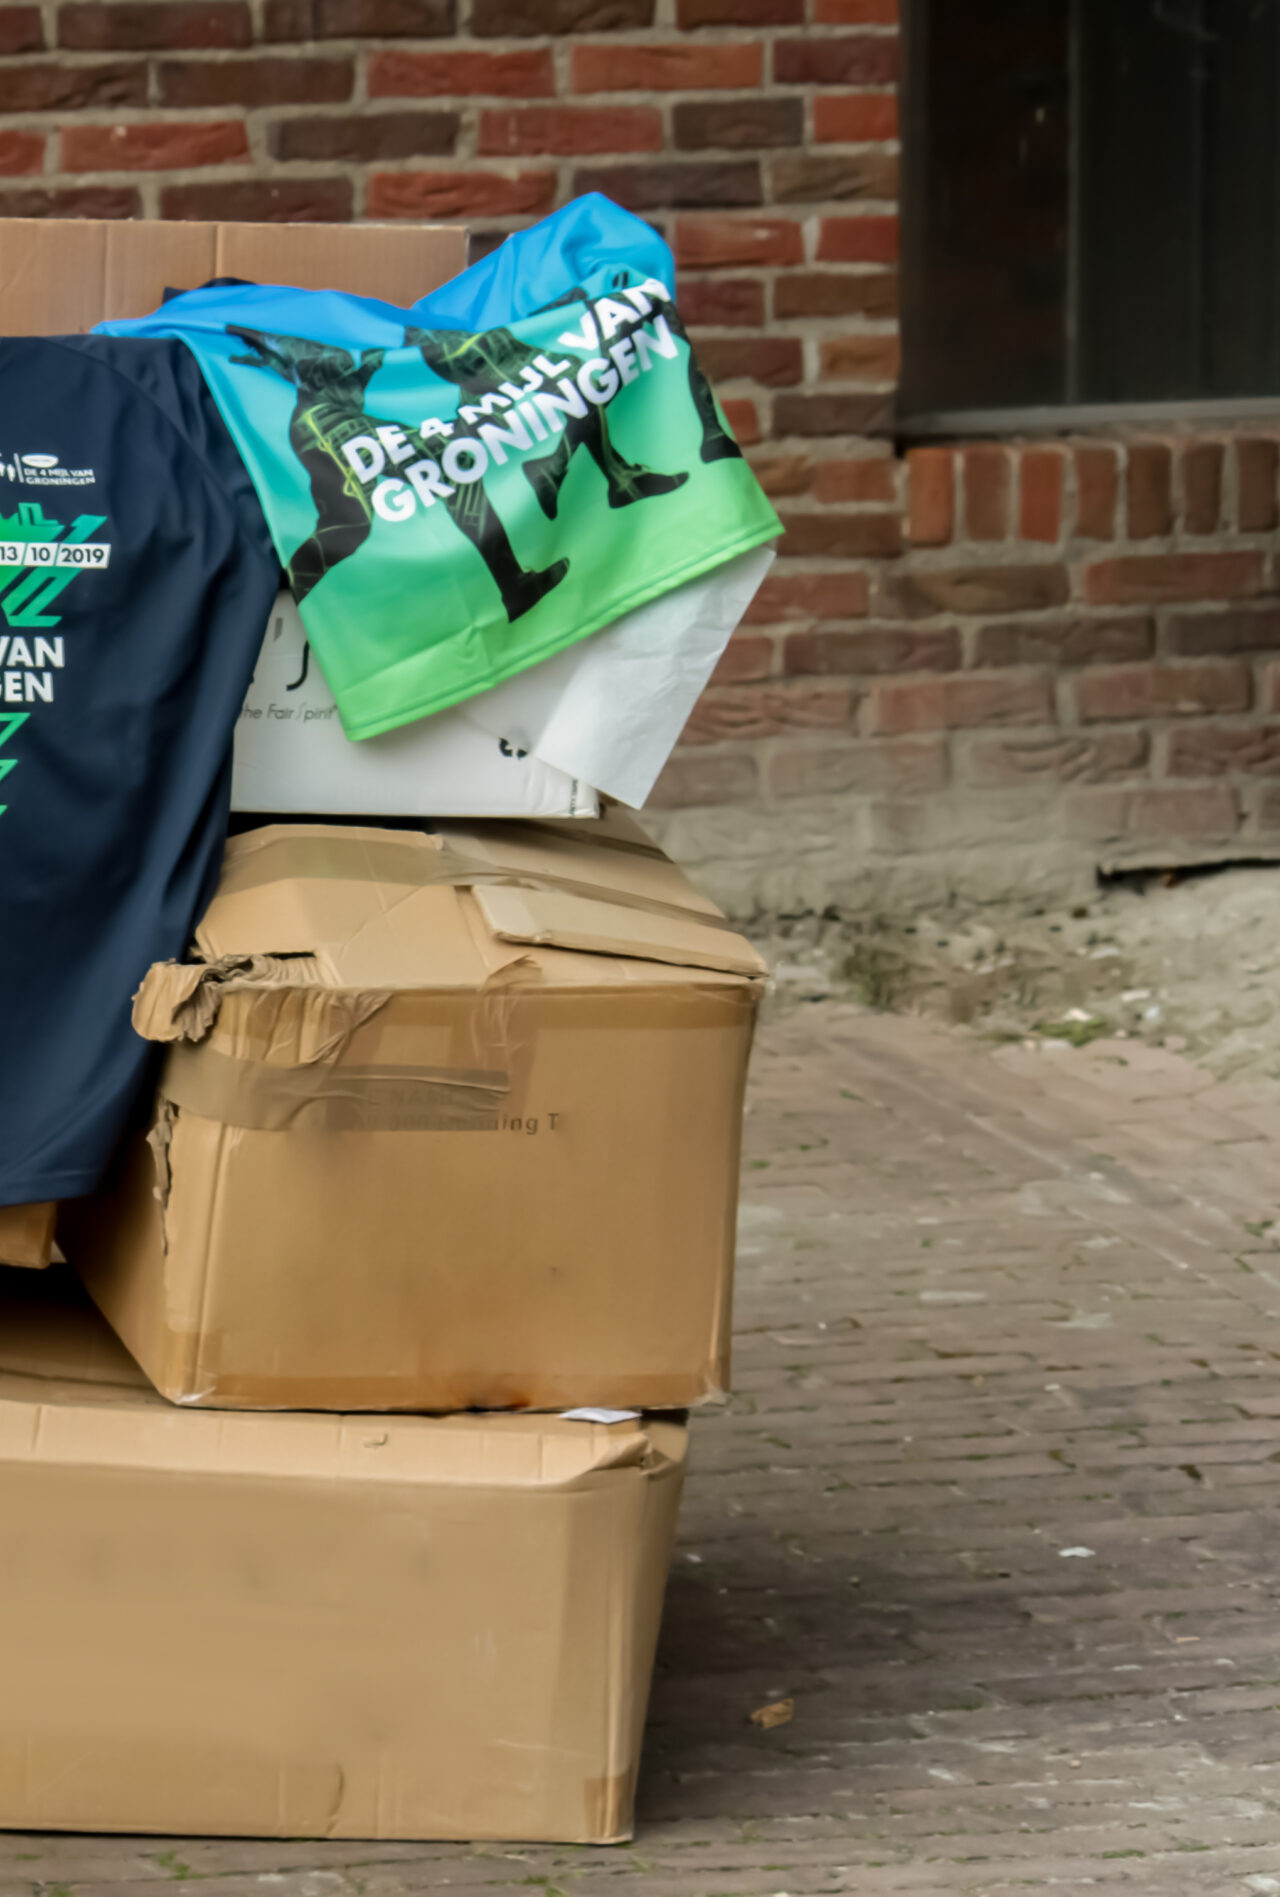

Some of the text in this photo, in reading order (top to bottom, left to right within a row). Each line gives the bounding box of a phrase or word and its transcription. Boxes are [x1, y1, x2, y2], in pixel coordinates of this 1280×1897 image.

[341, 277, 671, 484] DE 4 MIJL VAN
[371, 314, 679, 522] GRONINGEN
[23, 468, 37, 476] DE
[71, 469, 93, 477] VAN
[25, 477, 96, 485] GRONINGEN
[267, 703, 294, 720] Fair
